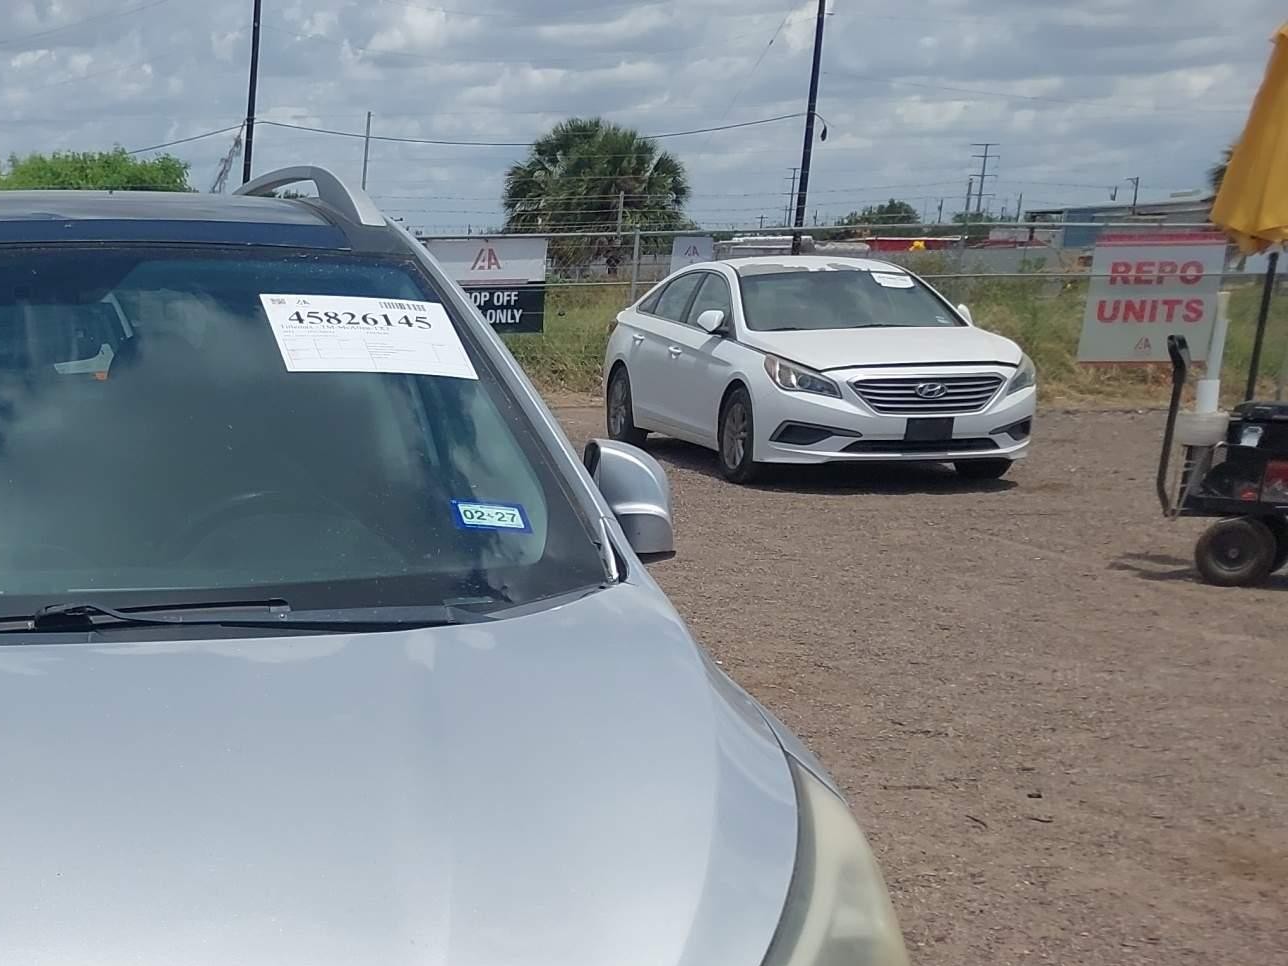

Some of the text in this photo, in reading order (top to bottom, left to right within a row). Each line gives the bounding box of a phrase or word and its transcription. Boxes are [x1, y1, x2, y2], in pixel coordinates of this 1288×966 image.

[1109, 260, 1204, 286] REPO
[493, 291, 519, 306] OFF
[288, 310, 432, 330] 45826145
[486, 308, 523, 324] ONLY
[1097, 299, 1204, 323] UNITS
